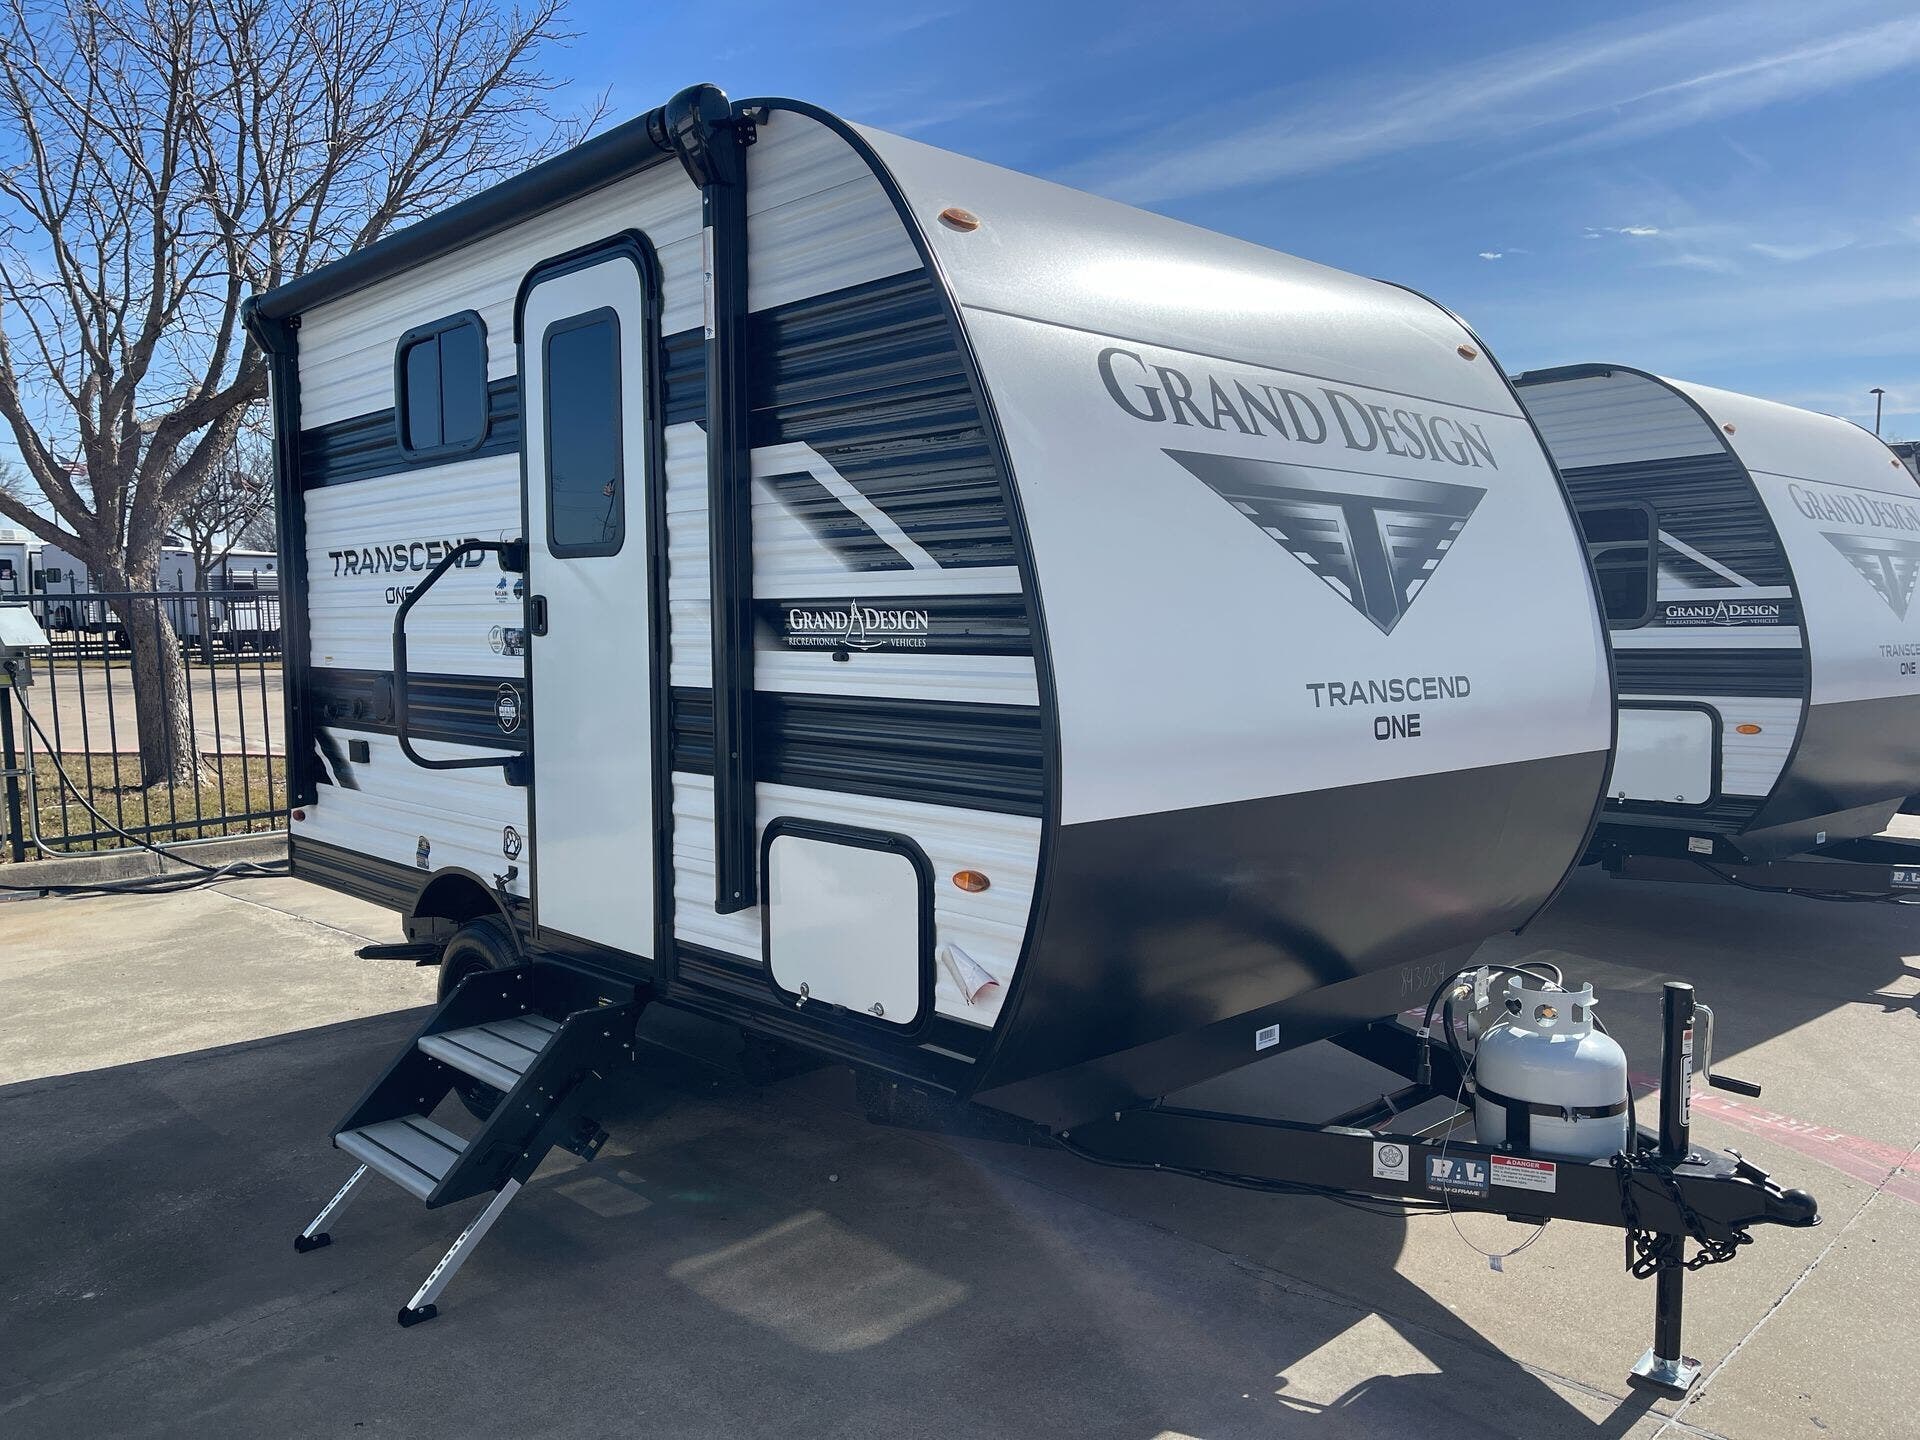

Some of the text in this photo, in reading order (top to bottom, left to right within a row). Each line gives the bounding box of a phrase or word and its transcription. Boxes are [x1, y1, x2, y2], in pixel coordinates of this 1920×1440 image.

[1097, 347, 1499, 472] GRAND DESIGN
[1787, 482, 1865, 526] GRAND
[328, 537, 486, 577] TRANSCEND
[789, 607, 928, 630] GRAND DESIGN
[1665, 604, 1779, 617] GRAND DESIGN
[788, 636, 927, 648] RECREATIONAL VEHICLES
[1900, 661, 1916, 676] ONE
[1306, 675, 1471, 708] TRANSCEND
[1374, 713, 1421, 741] ONE
[1431, 1158, 1485, 1183] BAL
[1512, 1160, 1540, 1169] DANGER
